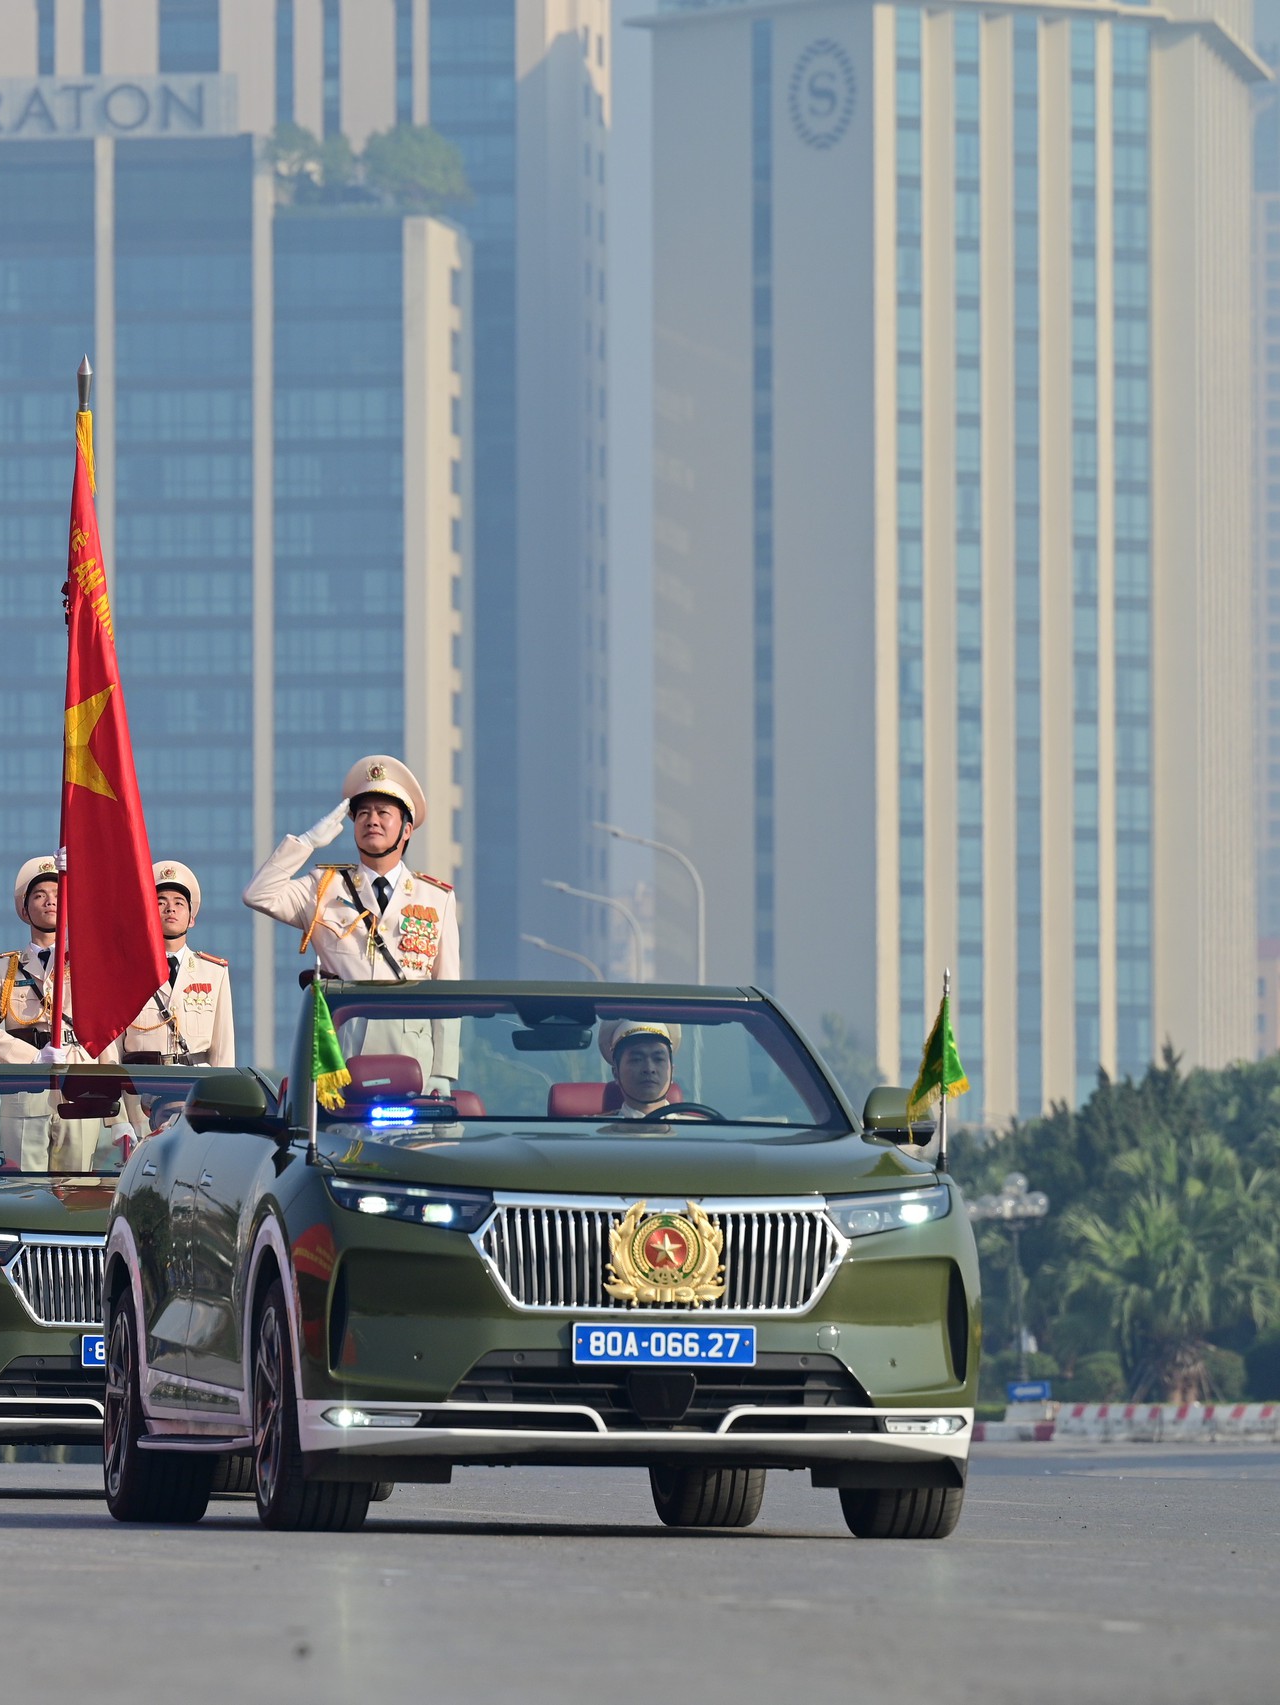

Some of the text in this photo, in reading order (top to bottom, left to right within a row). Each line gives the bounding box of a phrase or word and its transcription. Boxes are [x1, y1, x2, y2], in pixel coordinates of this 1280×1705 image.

[73, 557, 104, 594] AN
[91, 593, 114, 641] NIN
[589, 1331, 741, 1358] 80A-066.27
